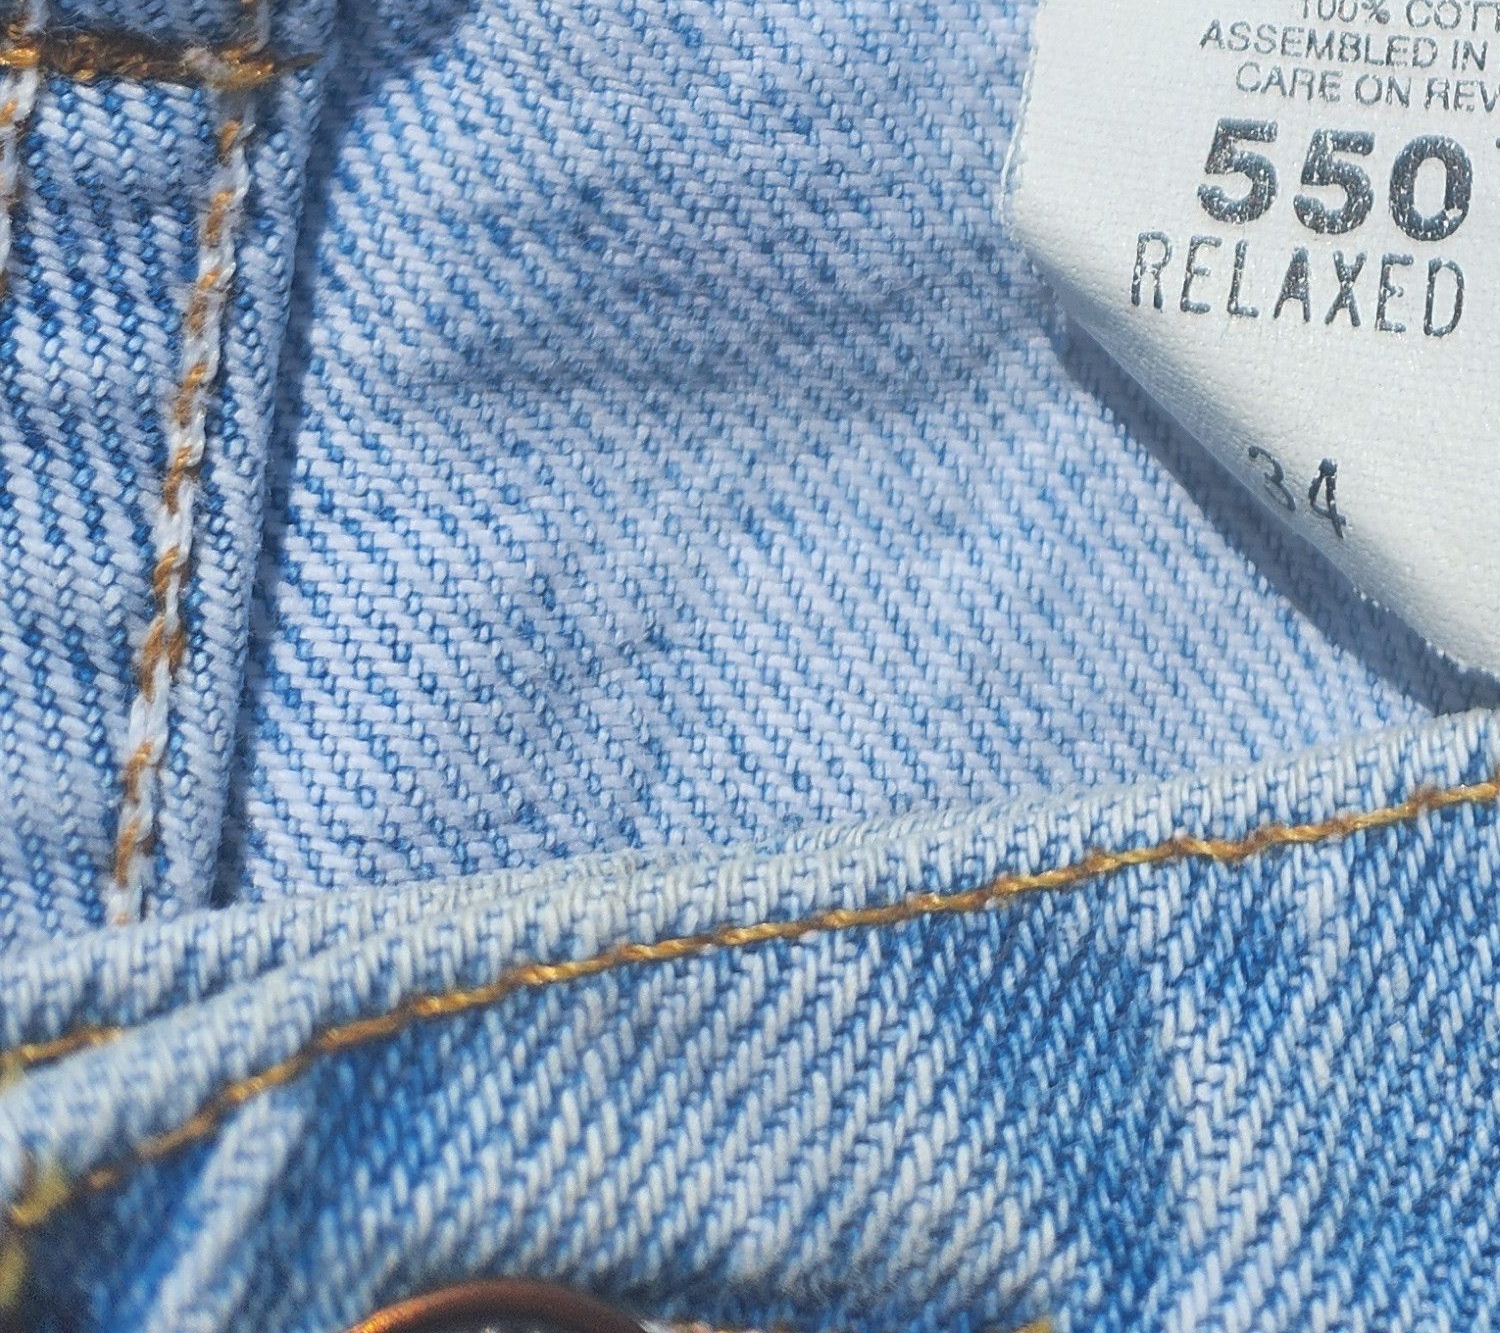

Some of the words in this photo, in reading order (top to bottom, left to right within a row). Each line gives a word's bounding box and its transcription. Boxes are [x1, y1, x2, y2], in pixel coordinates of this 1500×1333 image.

[1200, 19, 1438, 71] ASSEMBLED
[1448, 39, 1488, 70] IN
[1235, 62, 1341, 104] CARE
[1355, 74, 1412, 108] ON
[1131, 231, 1465, 338] RELAXED
[1248, 445, 1346, 536] 34
